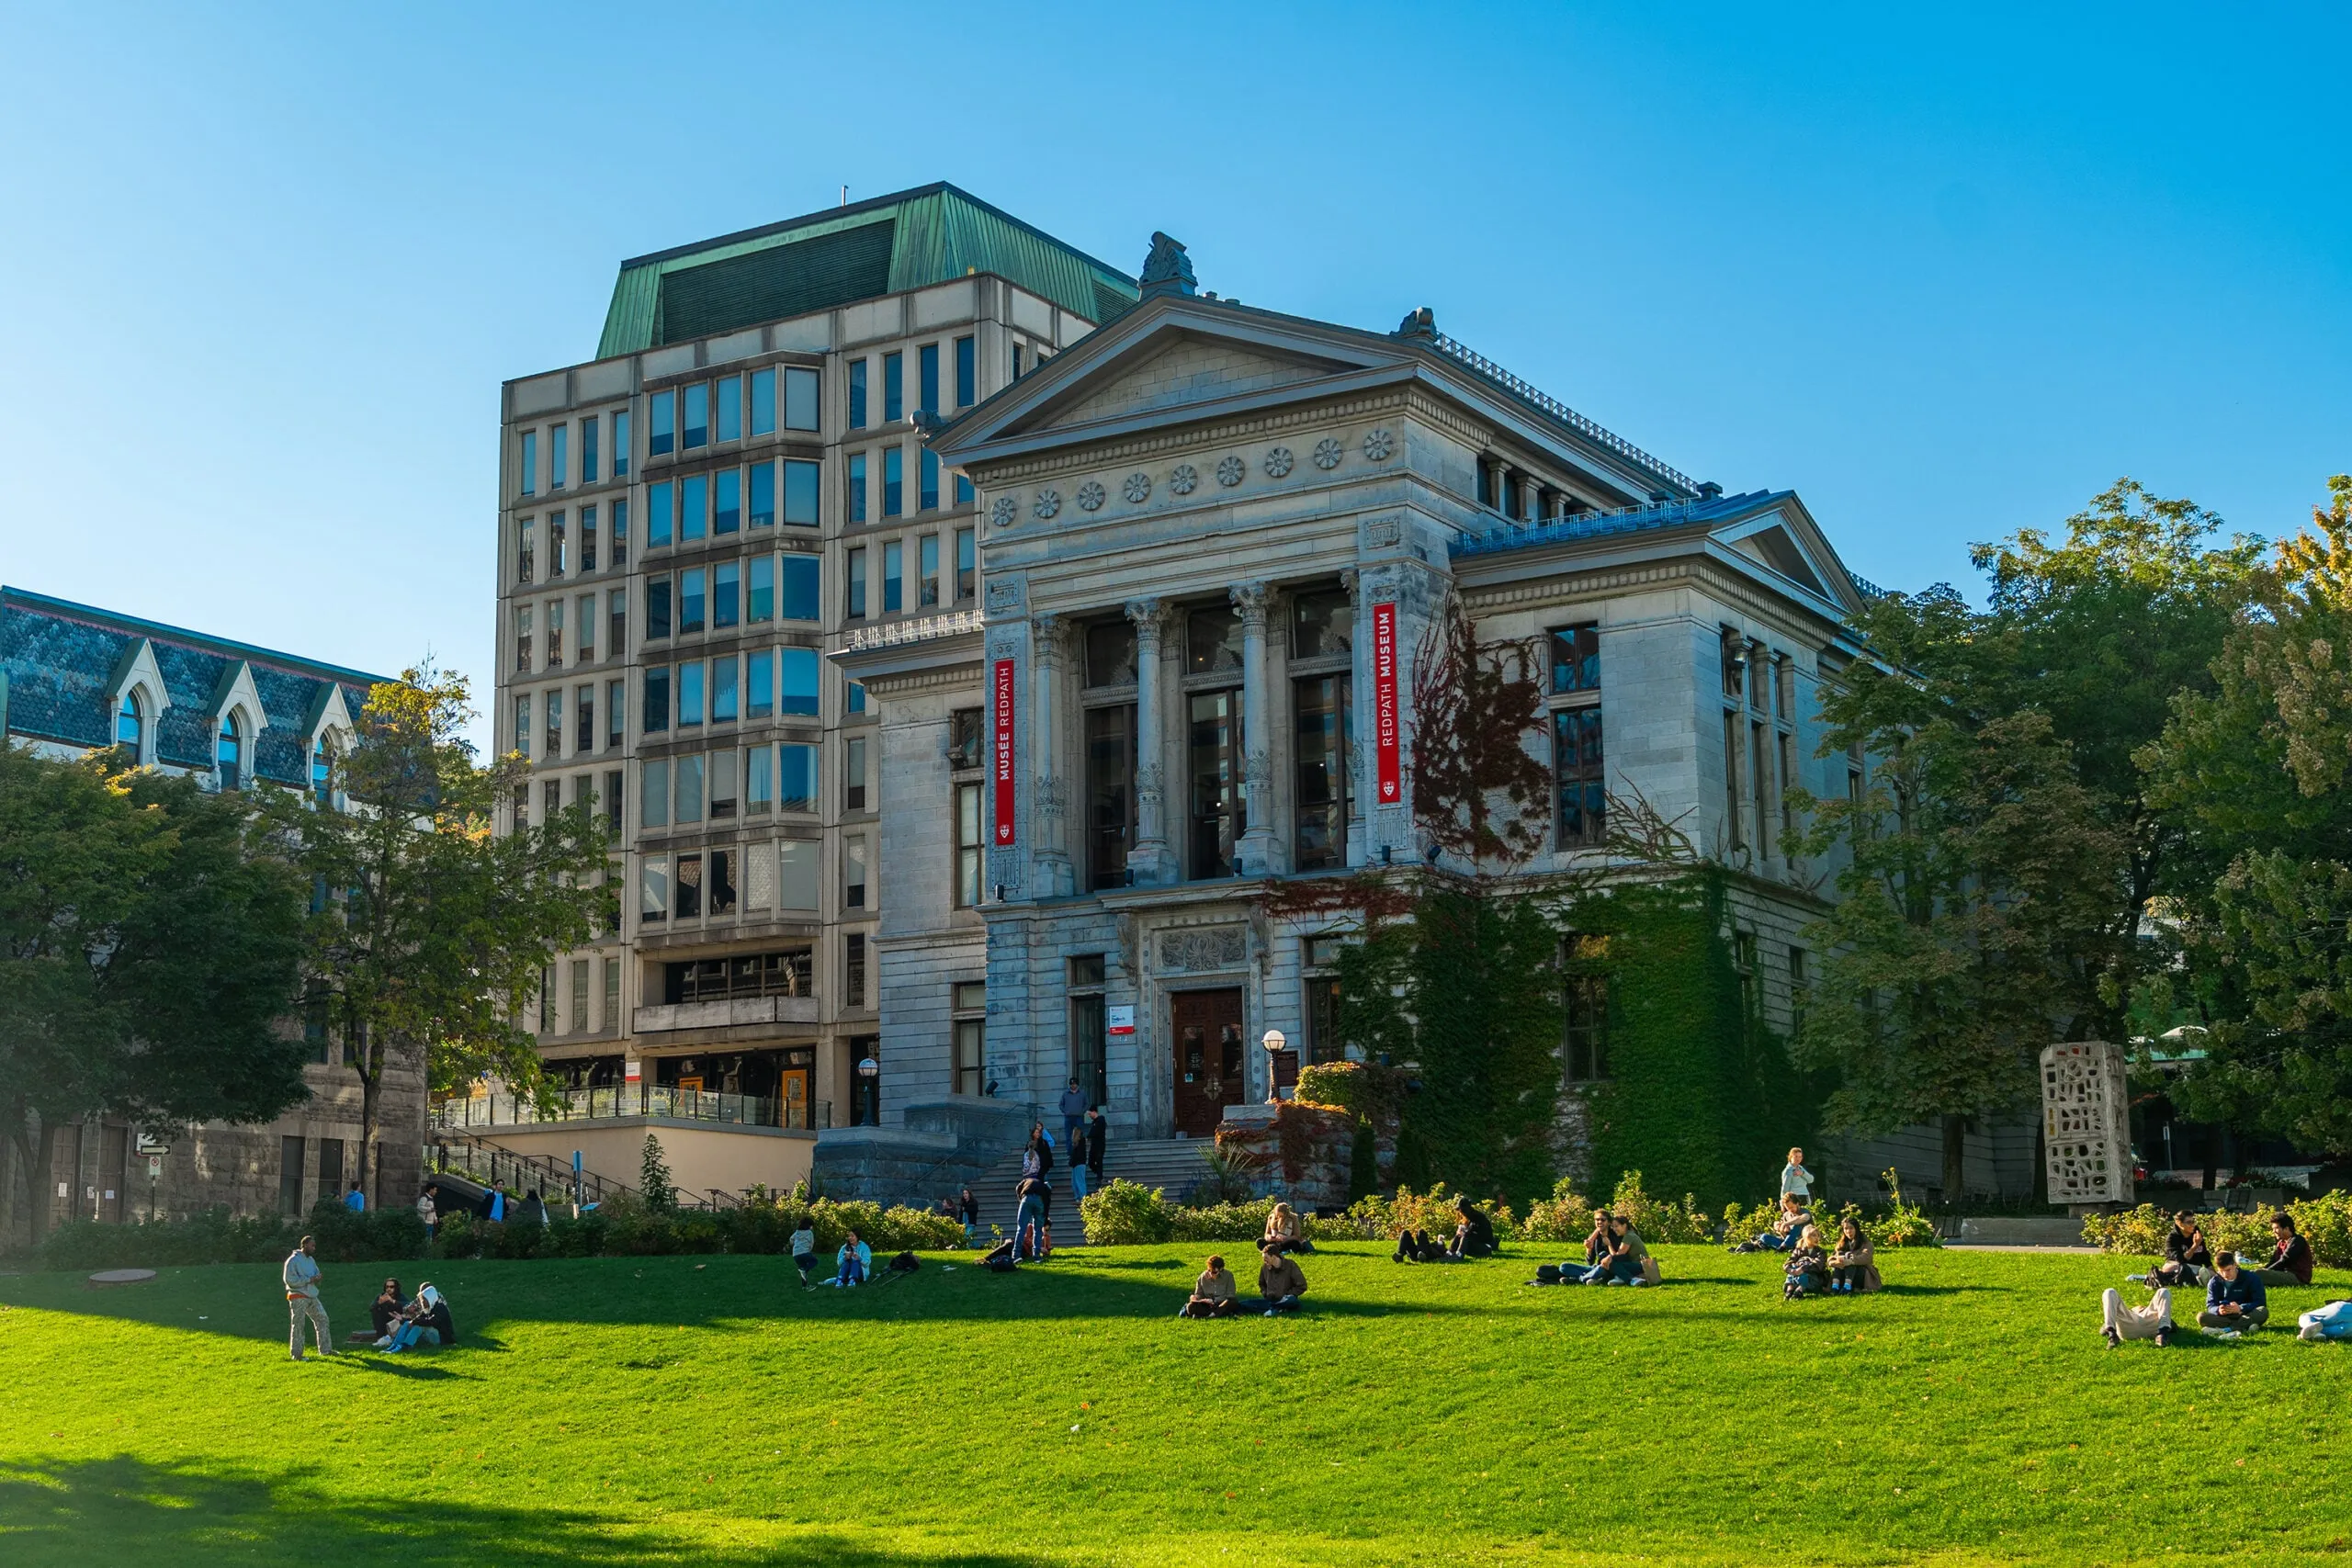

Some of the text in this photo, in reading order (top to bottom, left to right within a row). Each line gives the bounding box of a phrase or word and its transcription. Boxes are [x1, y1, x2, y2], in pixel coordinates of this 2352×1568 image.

[999, 668, 1010, 781] MUSÉE REDPATH
[1379, 612, 1393, 747] REDPATH MUSEUM
